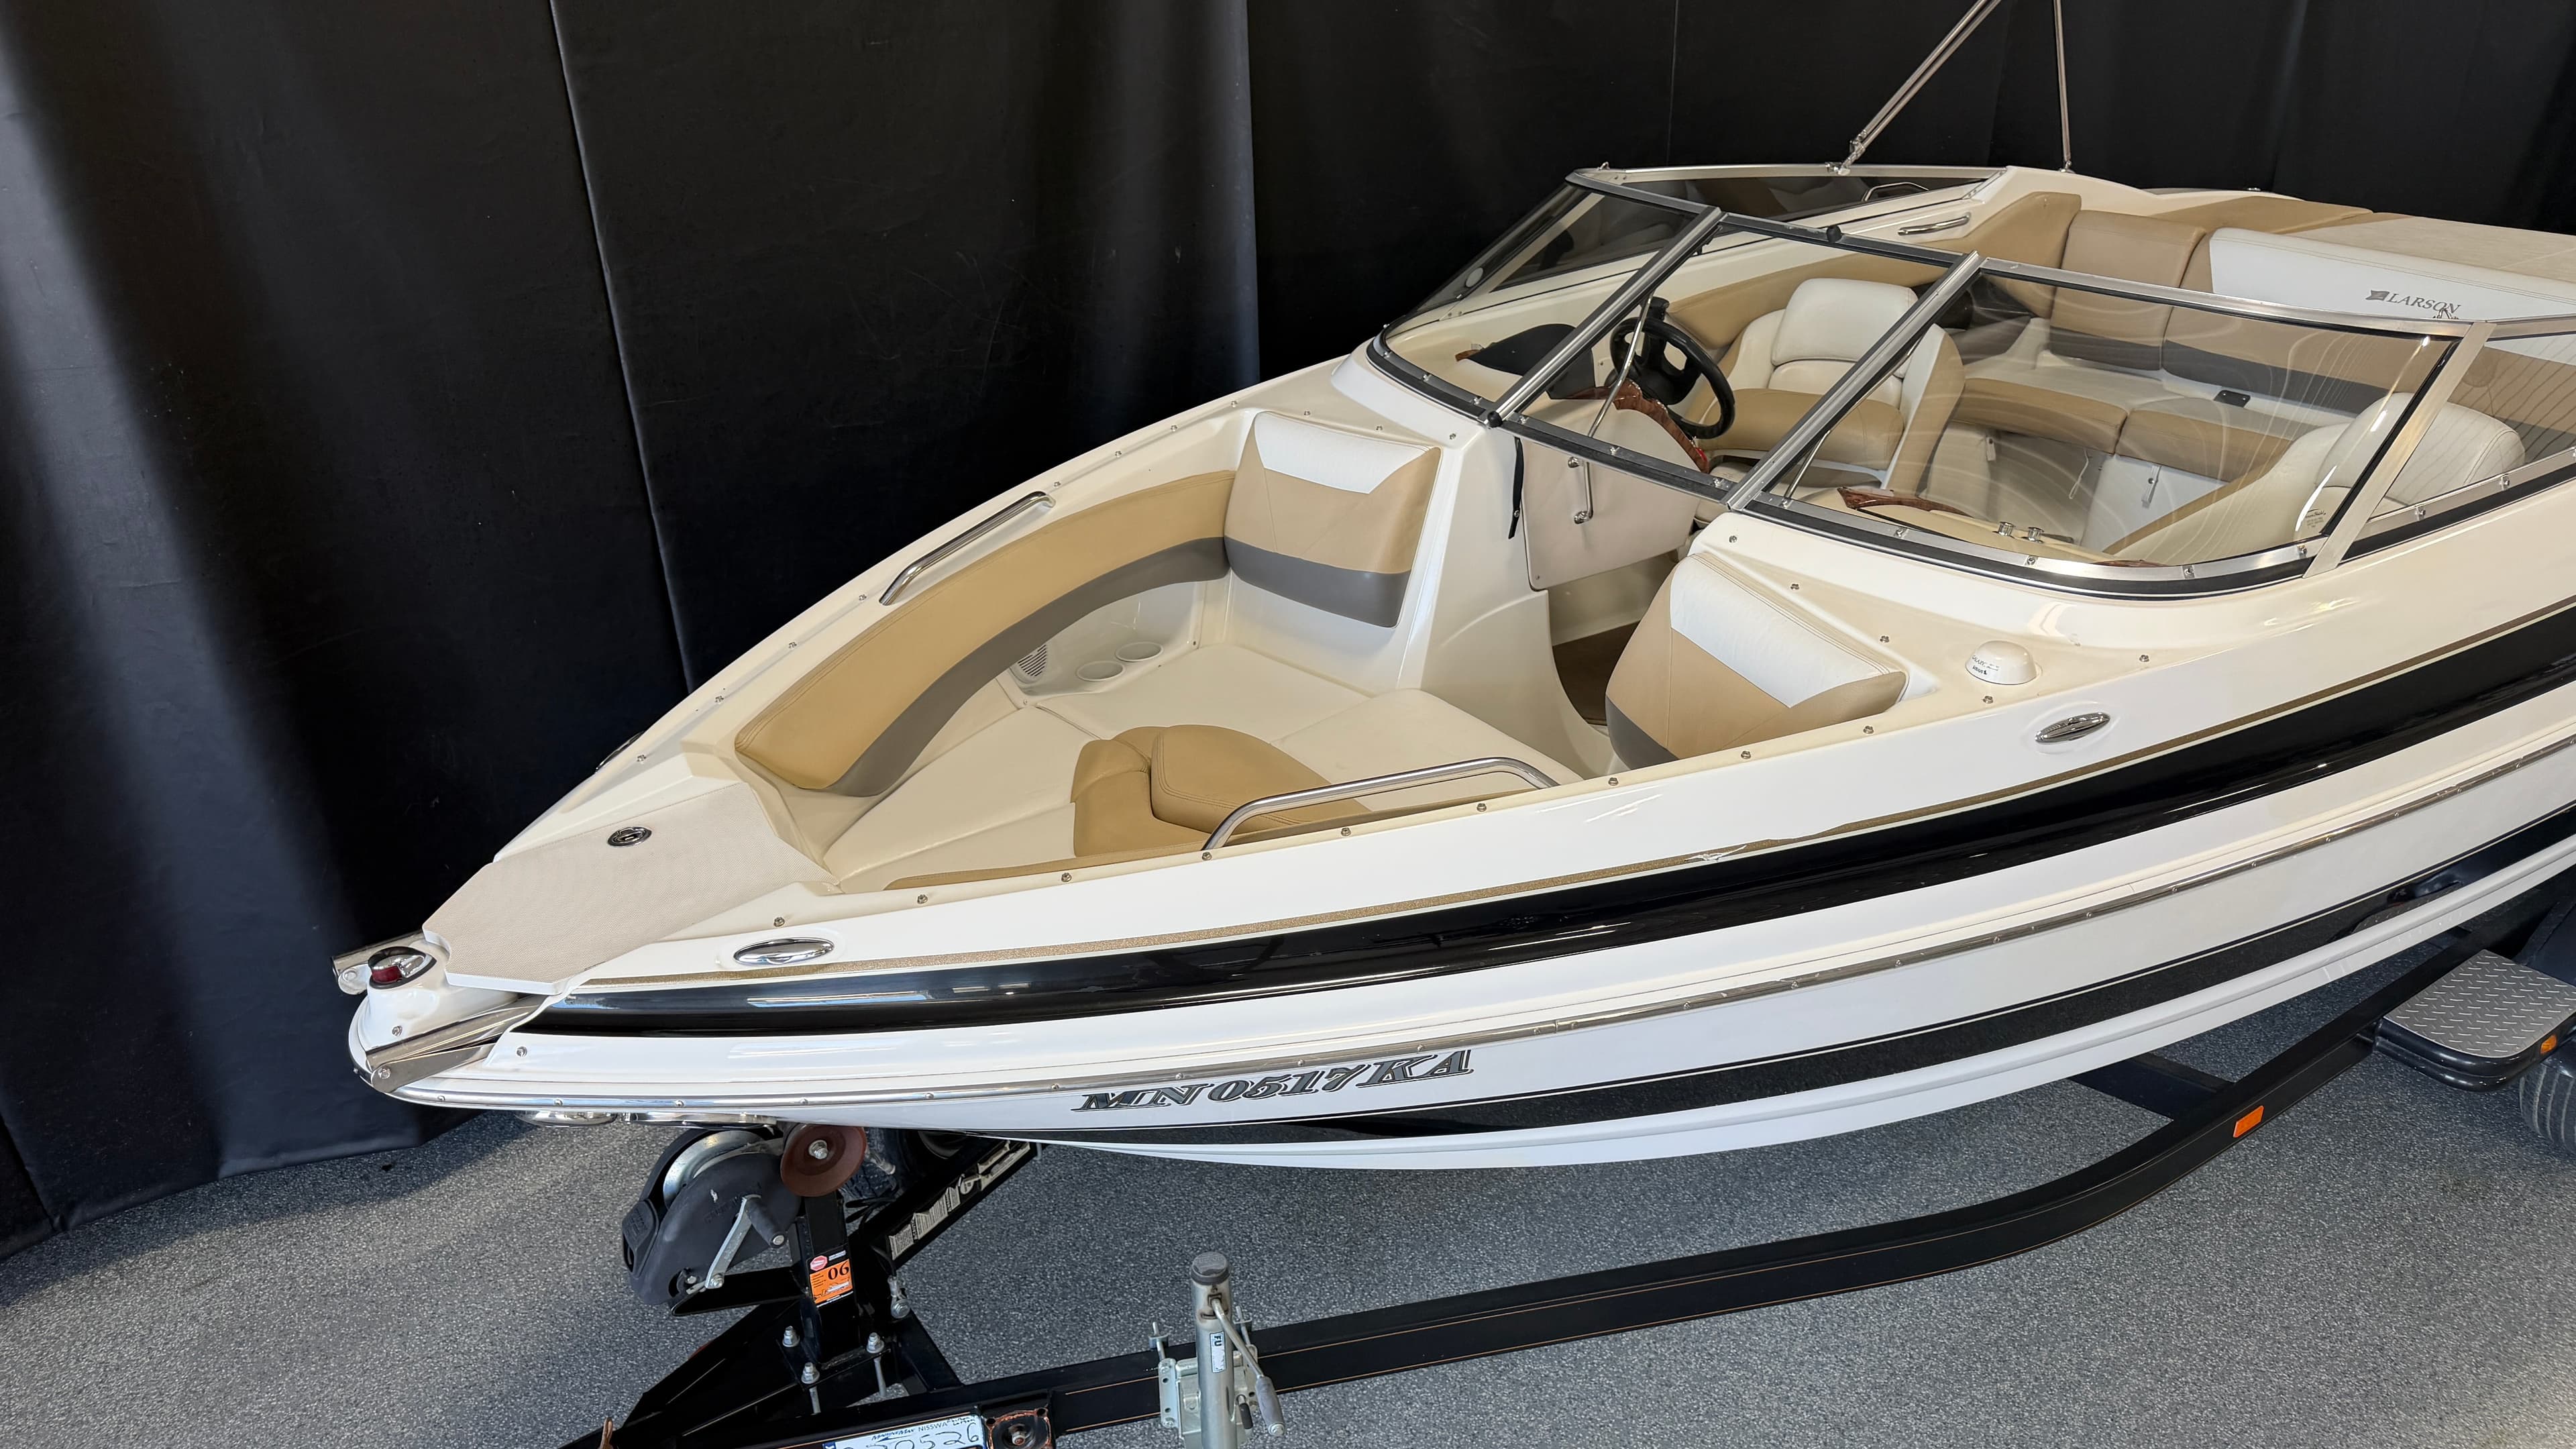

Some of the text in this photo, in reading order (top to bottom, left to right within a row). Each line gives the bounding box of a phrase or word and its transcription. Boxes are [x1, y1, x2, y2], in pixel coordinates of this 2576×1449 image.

[2386, 293, 2461, 314] LARSON
[828, 1261, 850, 1281] 06
[918, 1421, 948, 1432] NISSWA
